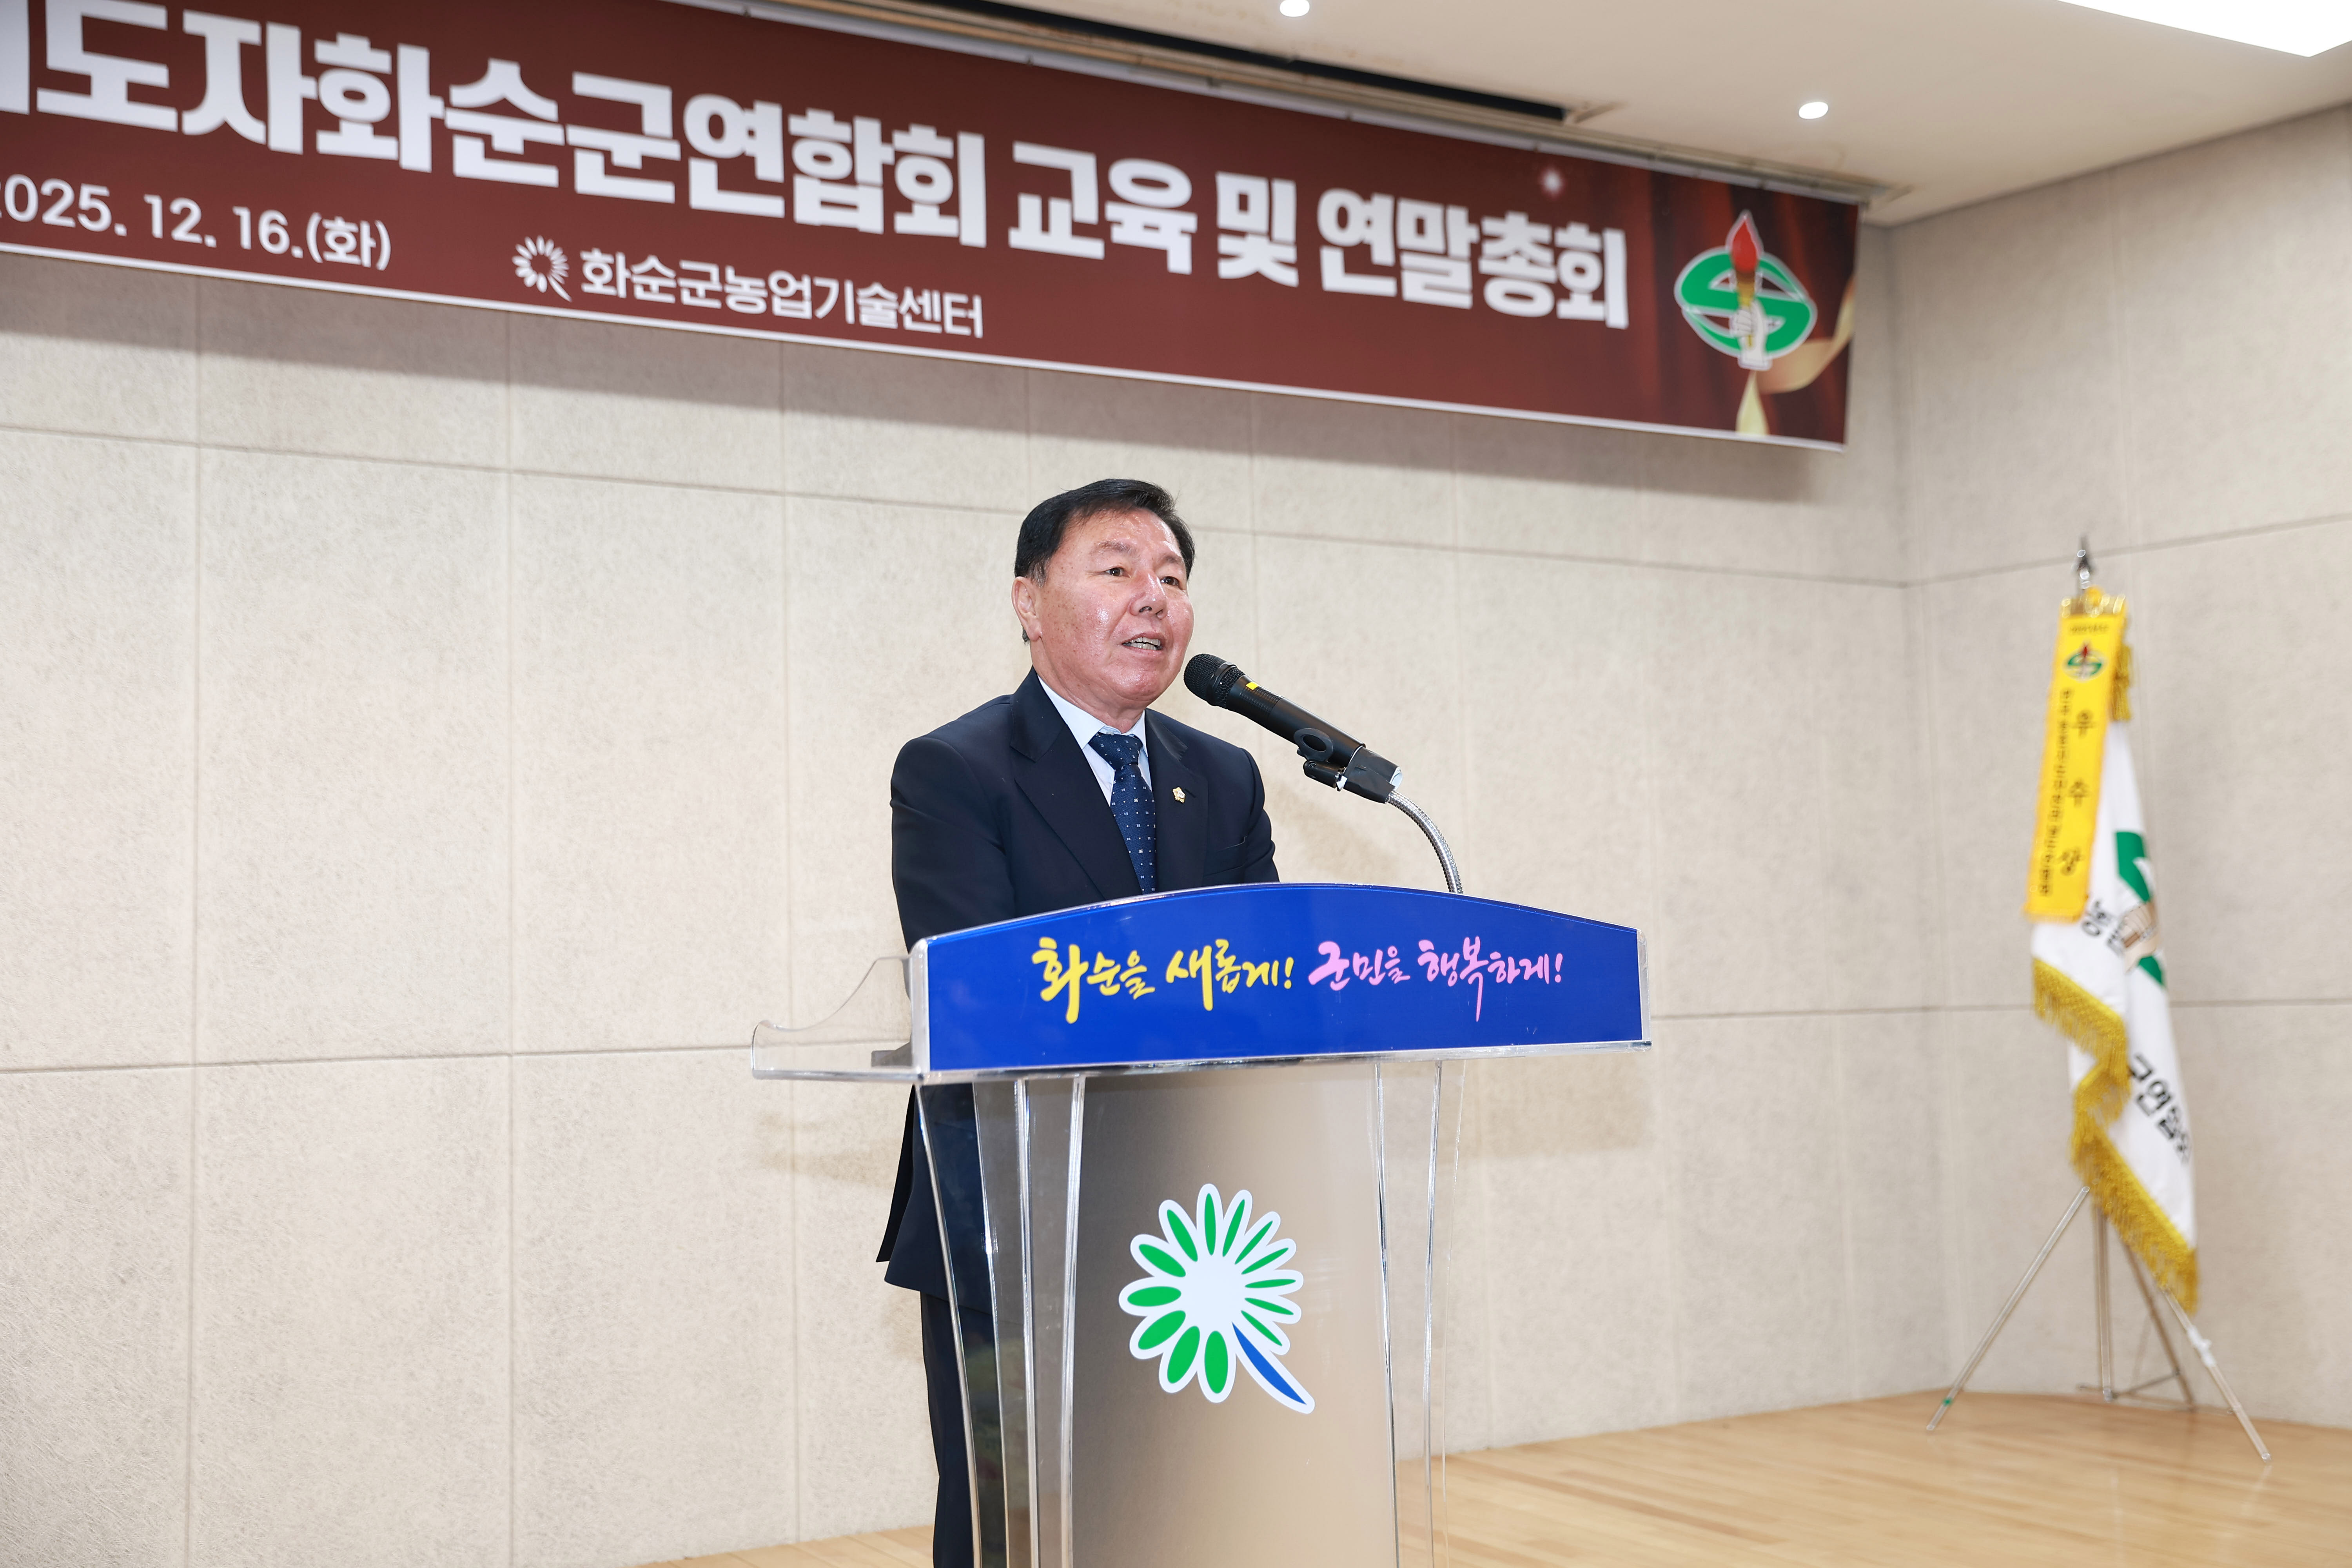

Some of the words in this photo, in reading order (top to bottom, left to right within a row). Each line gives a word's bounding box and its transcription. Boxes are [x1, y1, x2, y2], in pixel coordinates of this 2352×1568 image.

[0, 173, 127, 236] 025.
[143, 194, 217, 248] 12.
[232, 206, 391, 271] 16.(화)
[1008, 142, 1198, 275] 교육
[1216, 172, 1299, 287] 및
[1317, 189, 1629, 330] 연말총회
[580, 248, 984, 339] 화순군농업기술센터
[1031, 936, 1156, 1024] 화순을
[1165, 938, 1294, 1011] 새롭게!
[1308, 940, 1411, 991] 군민을
[1417, 936, 1563, 1022] 행복하게!
